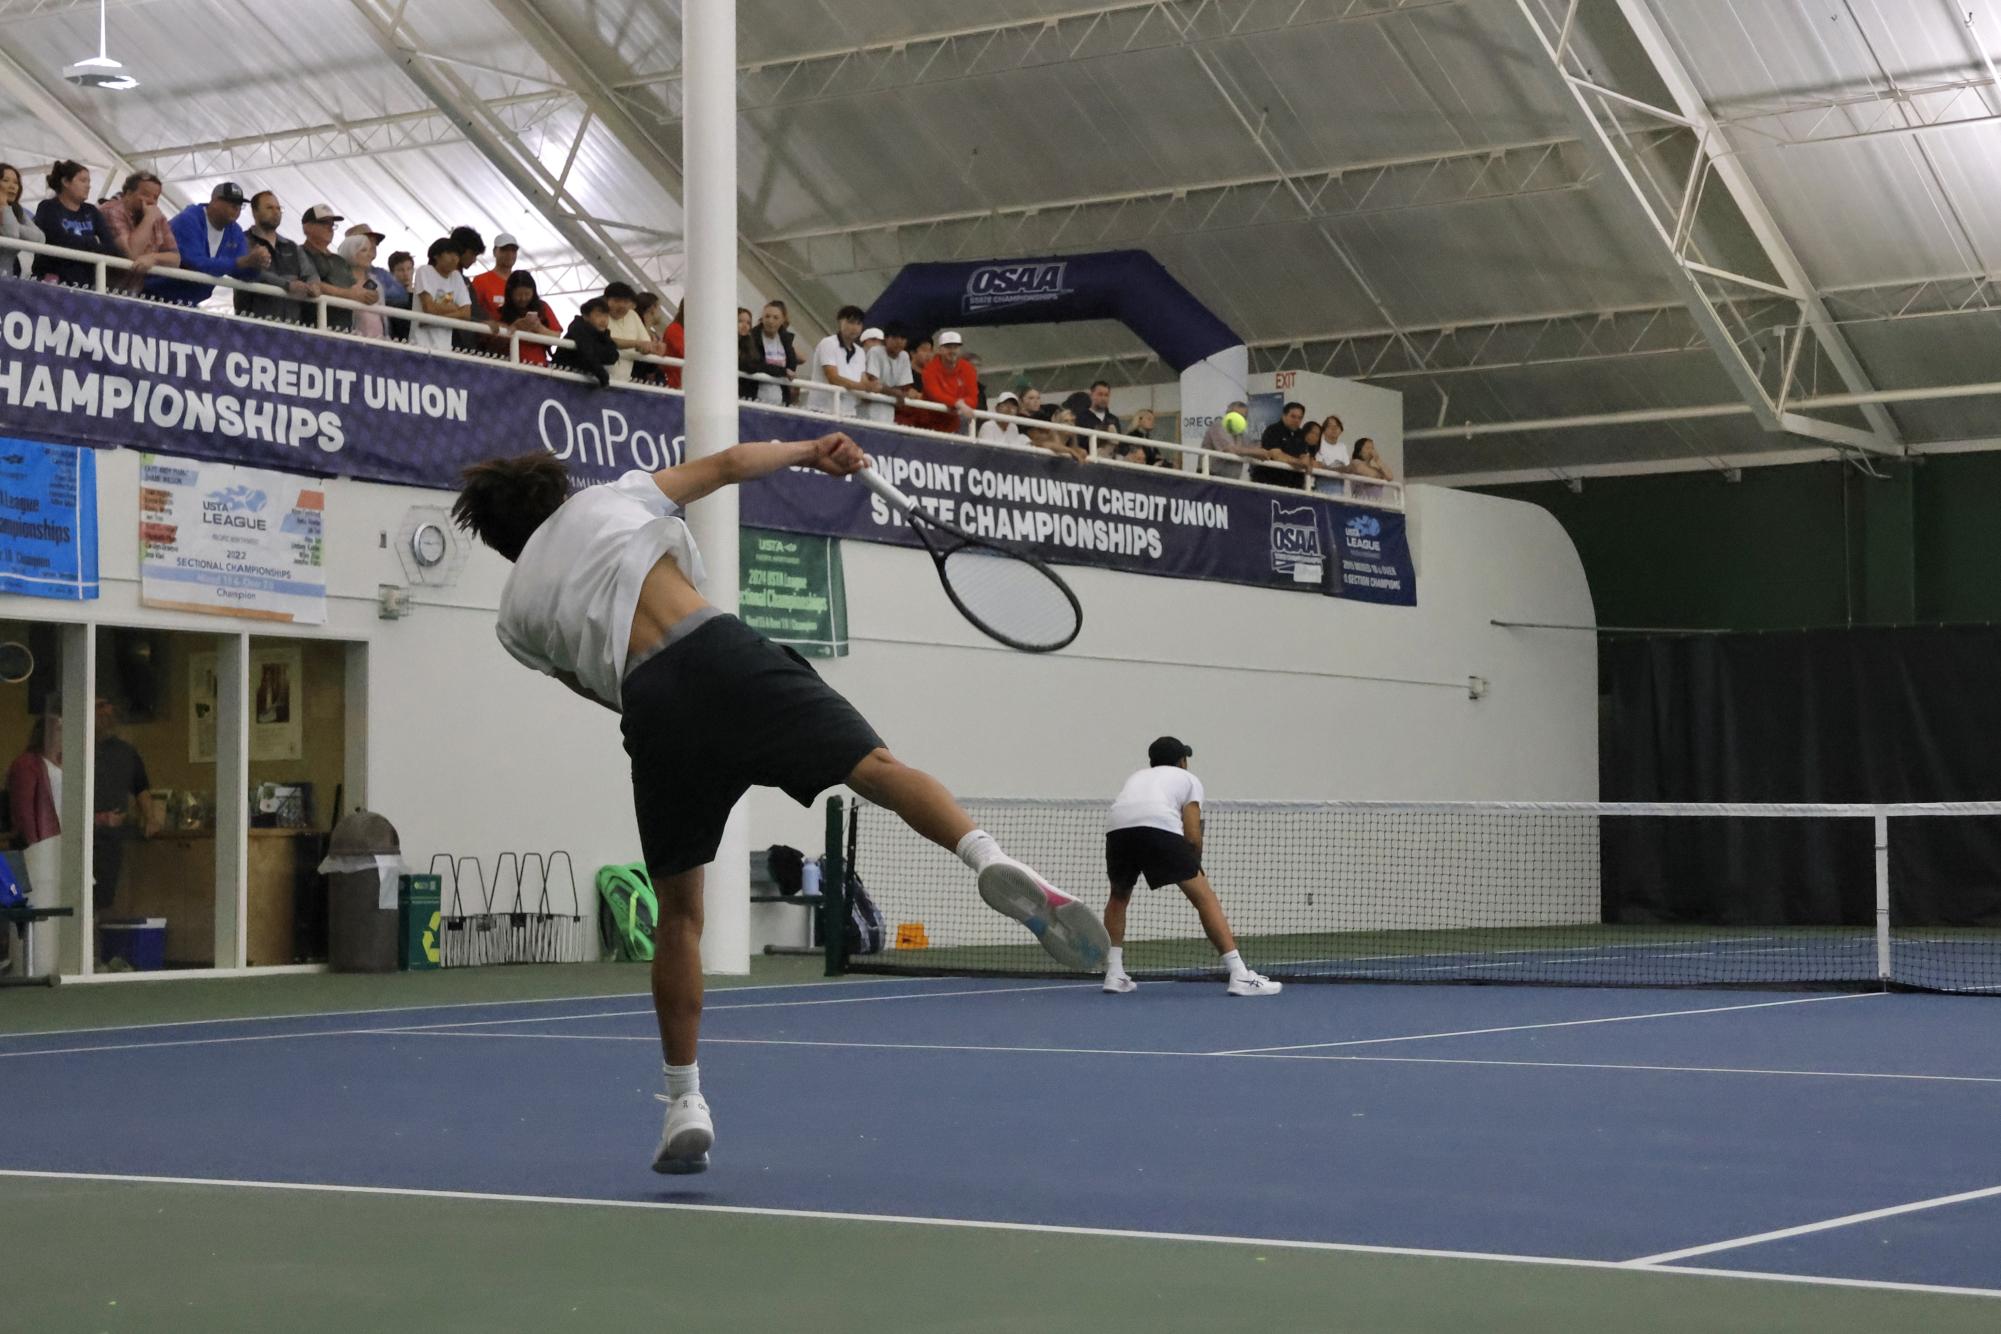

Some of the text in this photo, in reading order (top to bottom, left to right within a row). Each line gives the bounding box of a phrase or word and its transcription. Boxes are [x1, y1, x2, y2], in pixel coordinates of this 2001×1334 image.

[968, 263, 1064, 296] OSAA
[993, 293, 1058, 303] CHAMPIONSHIPS
[0, 311, 468, 421] OMMUNITY CREDIT UNION
[1276, 372, 1296, 389] EXIT
[203, 500, 229, 512] USTA
[967, 468, 1093, 511] COMMUNITY
[1098, 487, 1166, 522] CREDIT
[1170, 498, 1228, 530] UNION
[203, 512, 266, 531] LEAGUE
[959, 502, 1162, 559] CHAMPIONSHIPS
[758, 539, 784, 551] USTA
[1272, 526, 1319, 554] OSAA
[1346, 538, 1381, 551] LEAGUE
[227, 550, 247, 560] 2022
[176, 558, 292, 579] SECTIONAL CHAMPIONSHIPS
[216, 587, 257, 600] Champion
[767, 589, 828, 614] Championships
